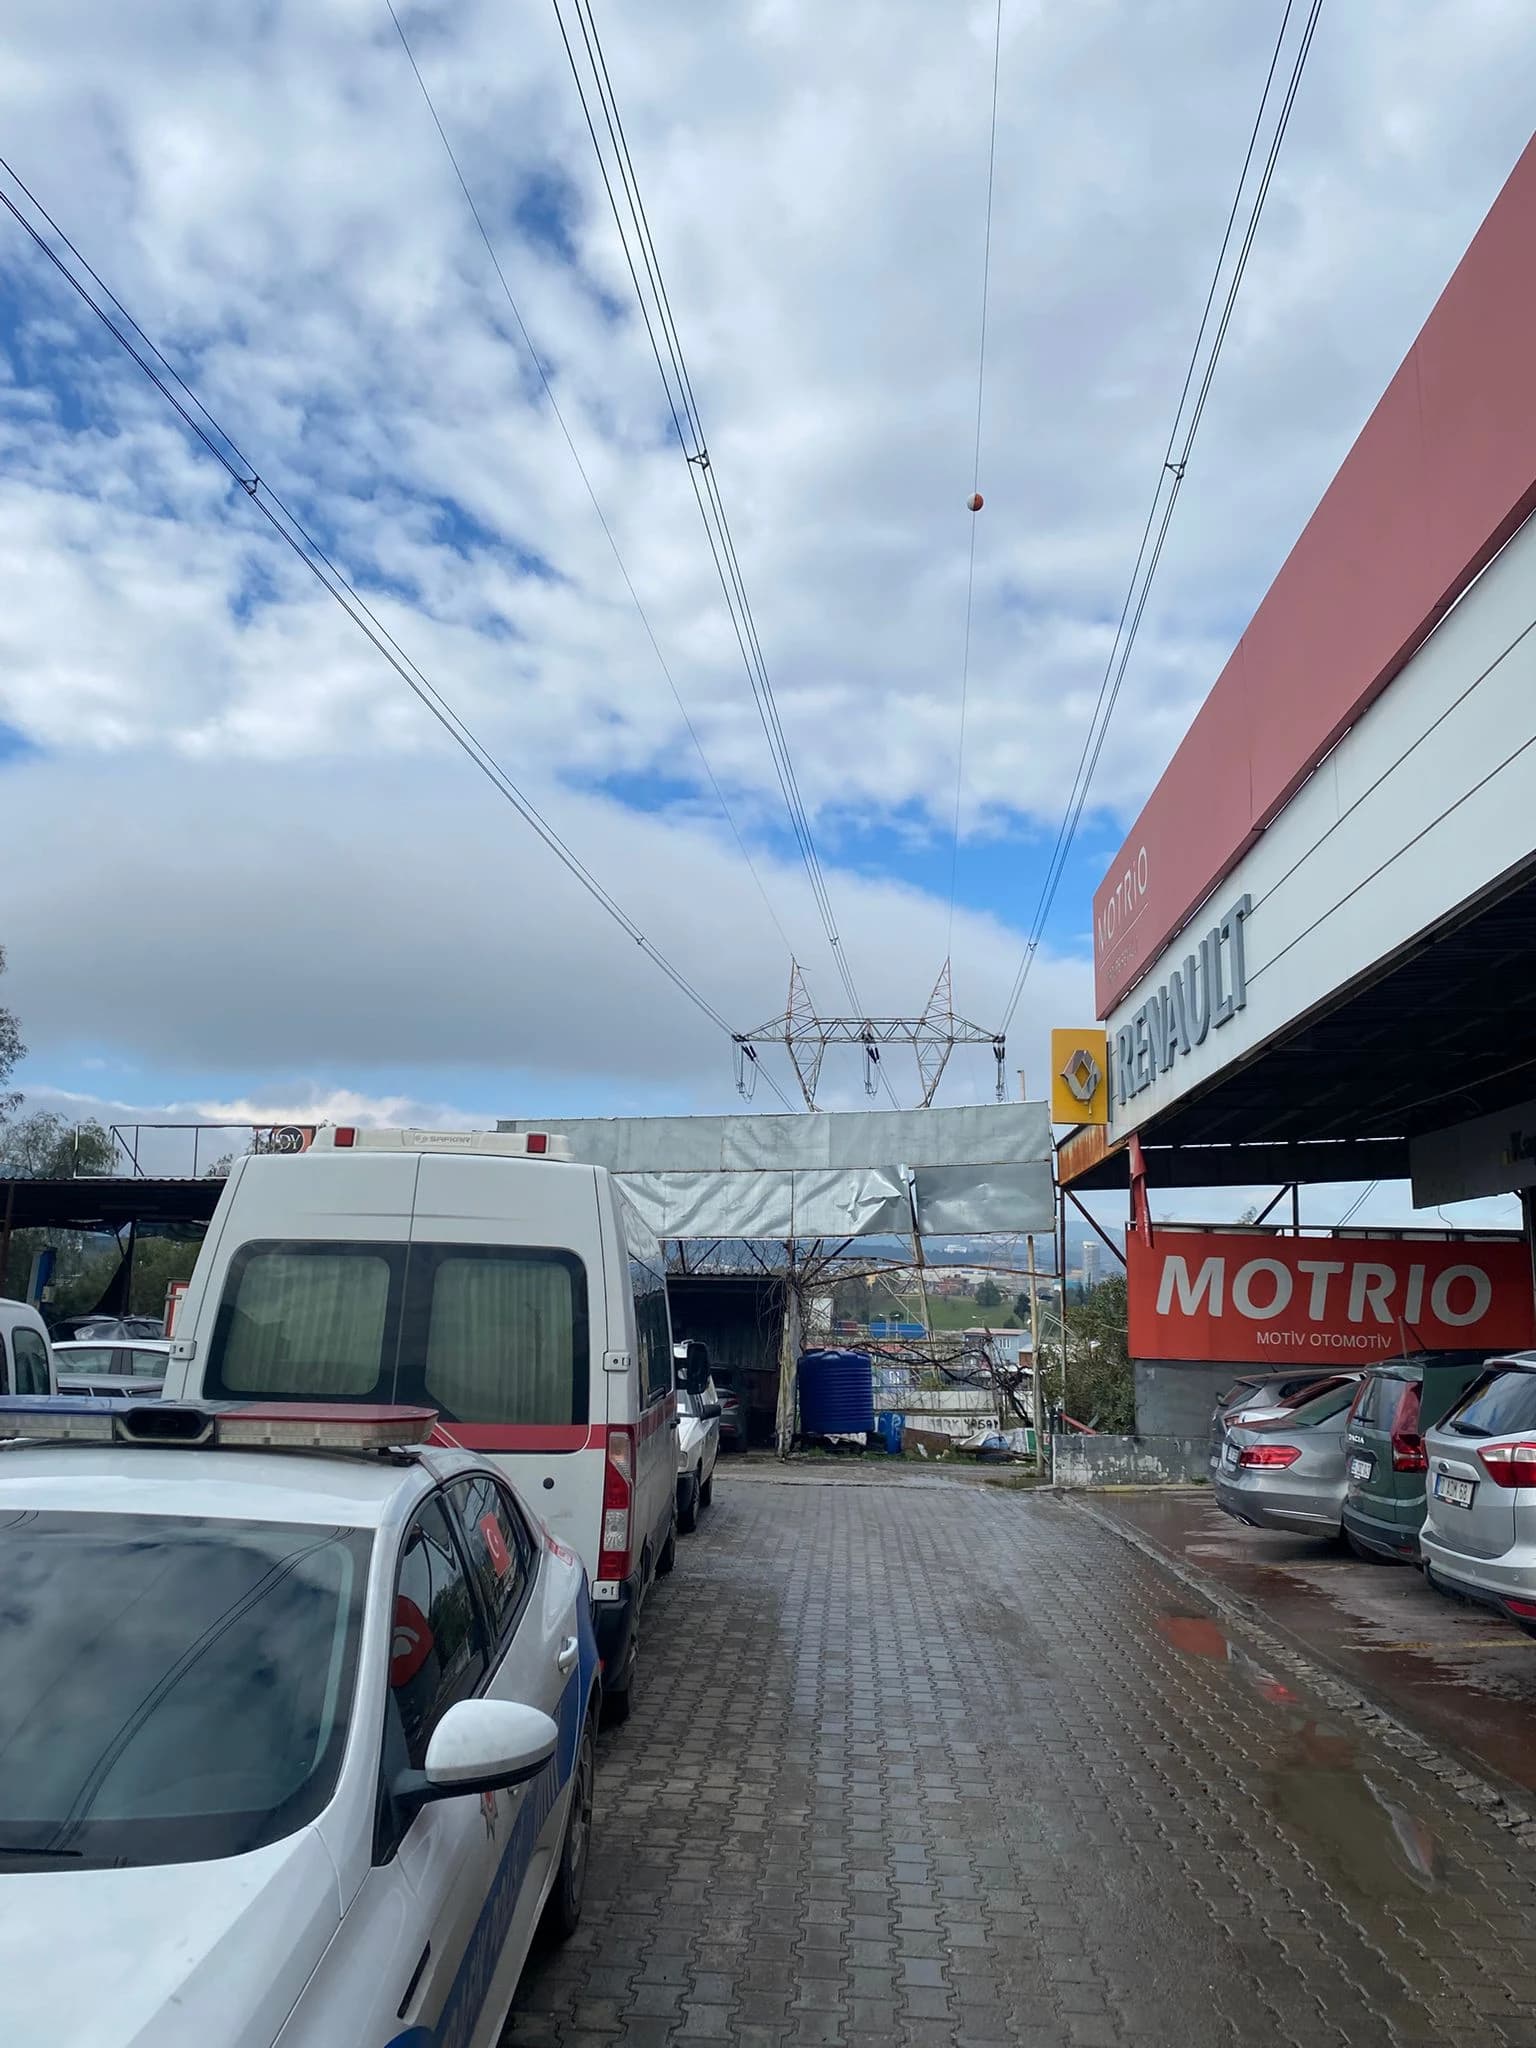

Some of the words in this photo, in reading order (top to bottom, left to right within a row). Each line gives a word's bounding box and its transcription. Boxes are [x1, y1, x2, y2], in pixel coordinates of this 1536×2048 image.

[1116, 893, 1251, 1105] RENAULT
[1155, 1255, 1492, 1327] MOTRIO
[1256, 1330, 1306, 1346] MOTİV
[1310, 1333, 1392, 1349] OTOMOTİV
